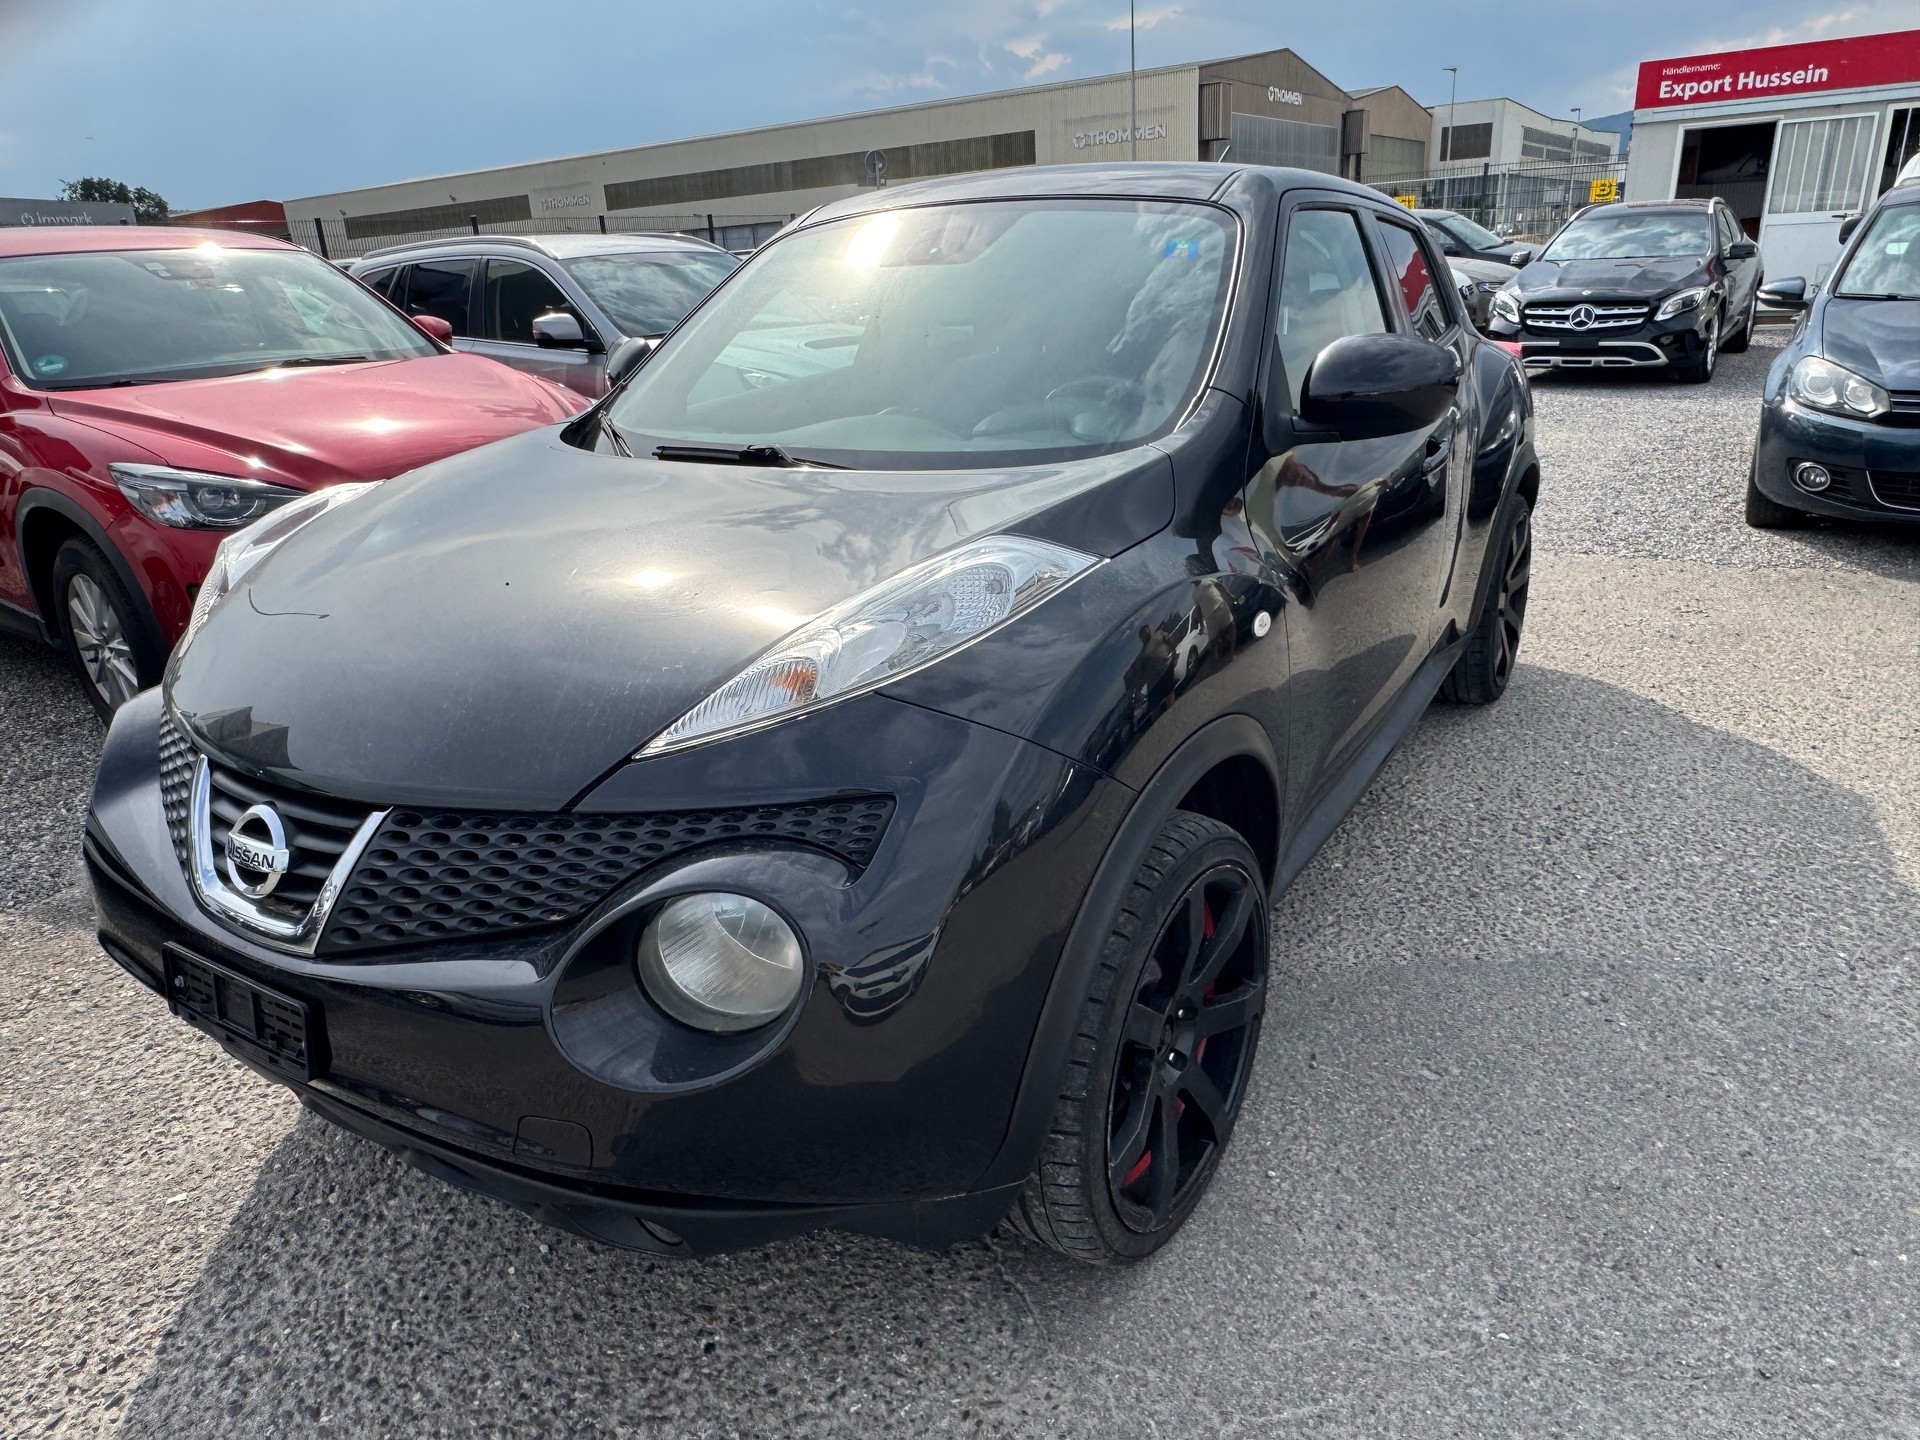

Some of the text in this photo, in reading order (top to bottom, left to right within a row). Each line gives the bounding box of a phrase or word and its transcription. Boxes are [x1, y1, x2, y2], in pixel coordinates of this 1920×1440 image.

[1662, 63, 1721, 76] Händlername:
[1659, 64, 1829, 100] Export Hussein
[1088, 123, 1167, 147] THOMMEN
[549, 194, 590, 209] THOMMEN
[228, 836, 275, 869] NISSAN
